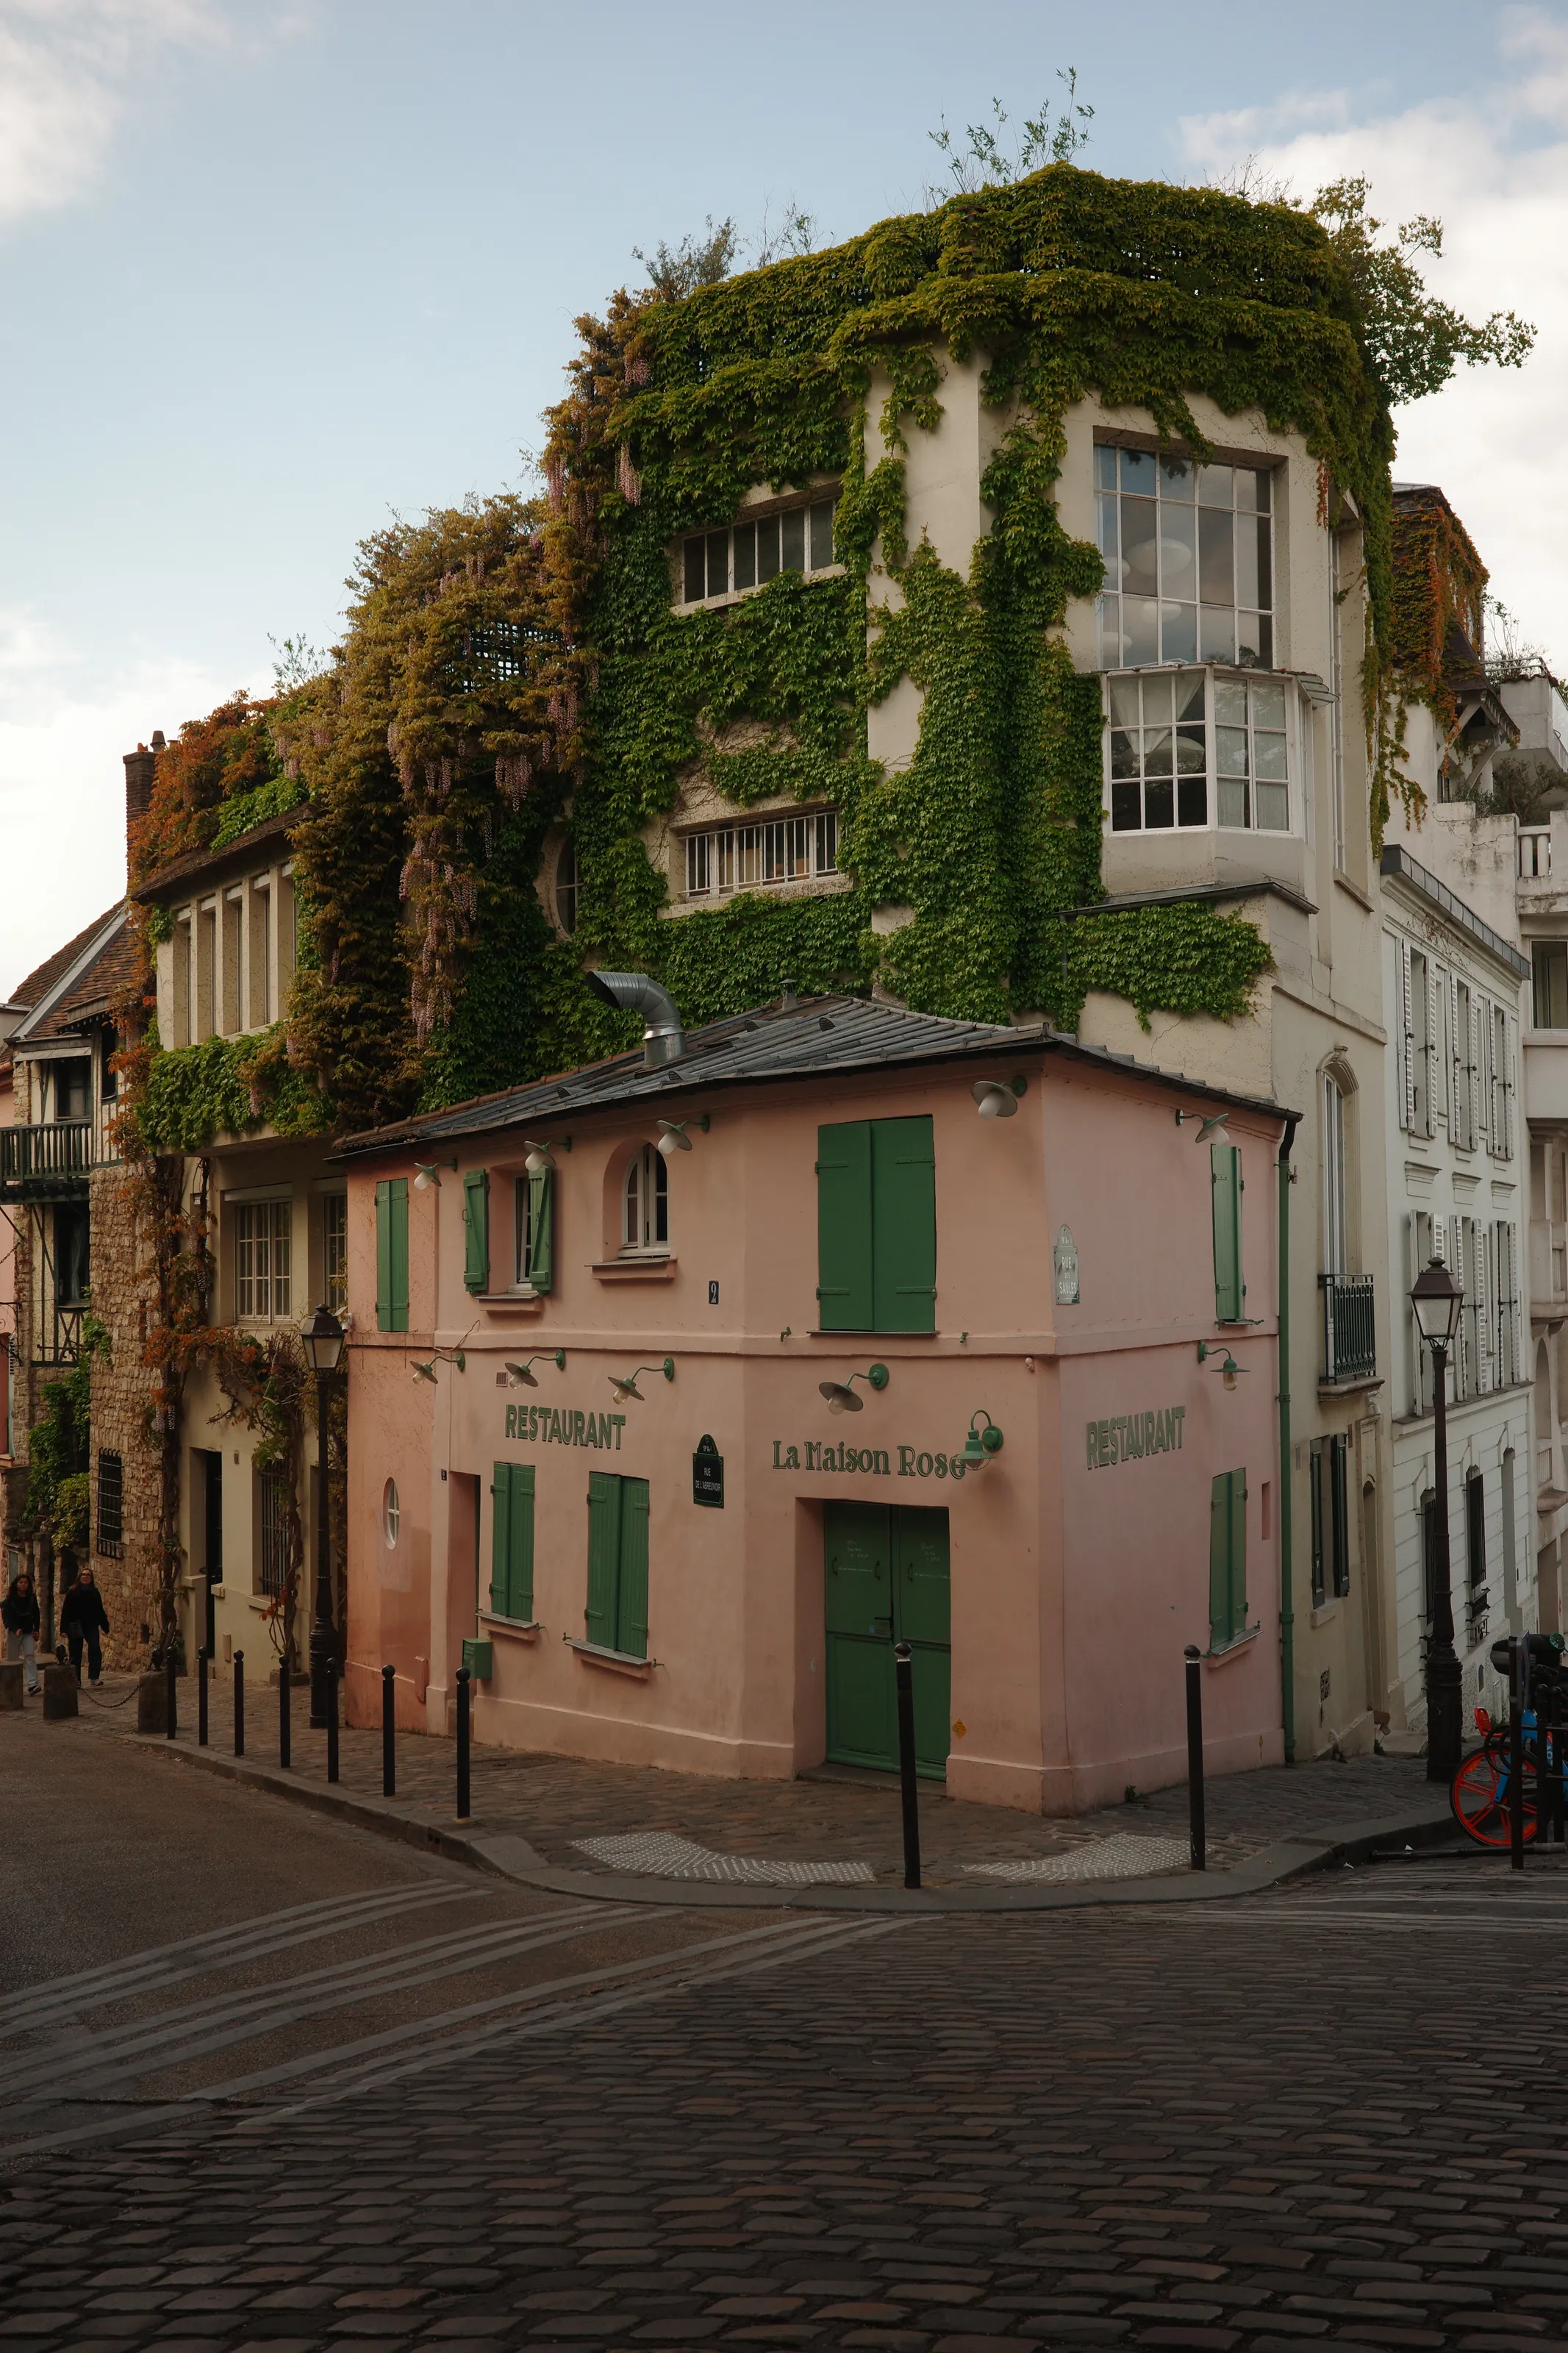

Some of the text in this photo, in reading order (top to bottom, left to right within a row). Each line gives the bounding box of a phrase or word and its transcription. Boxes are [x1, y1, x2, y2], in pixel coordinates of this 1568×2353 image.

[1062, 1256, 1072, 1269] RUE
[711, 1282, 717, 1304] 2
[1059, 1282, 1077, 1294] SAULES
[505, 1404, 626, 1450] RESTAURANT
[1086, 1406, 1186, 1470] RESTAURANT
[772, 1440, 967, 1479] La Maison Rose
[695, 1479, 700, 1489] DE
